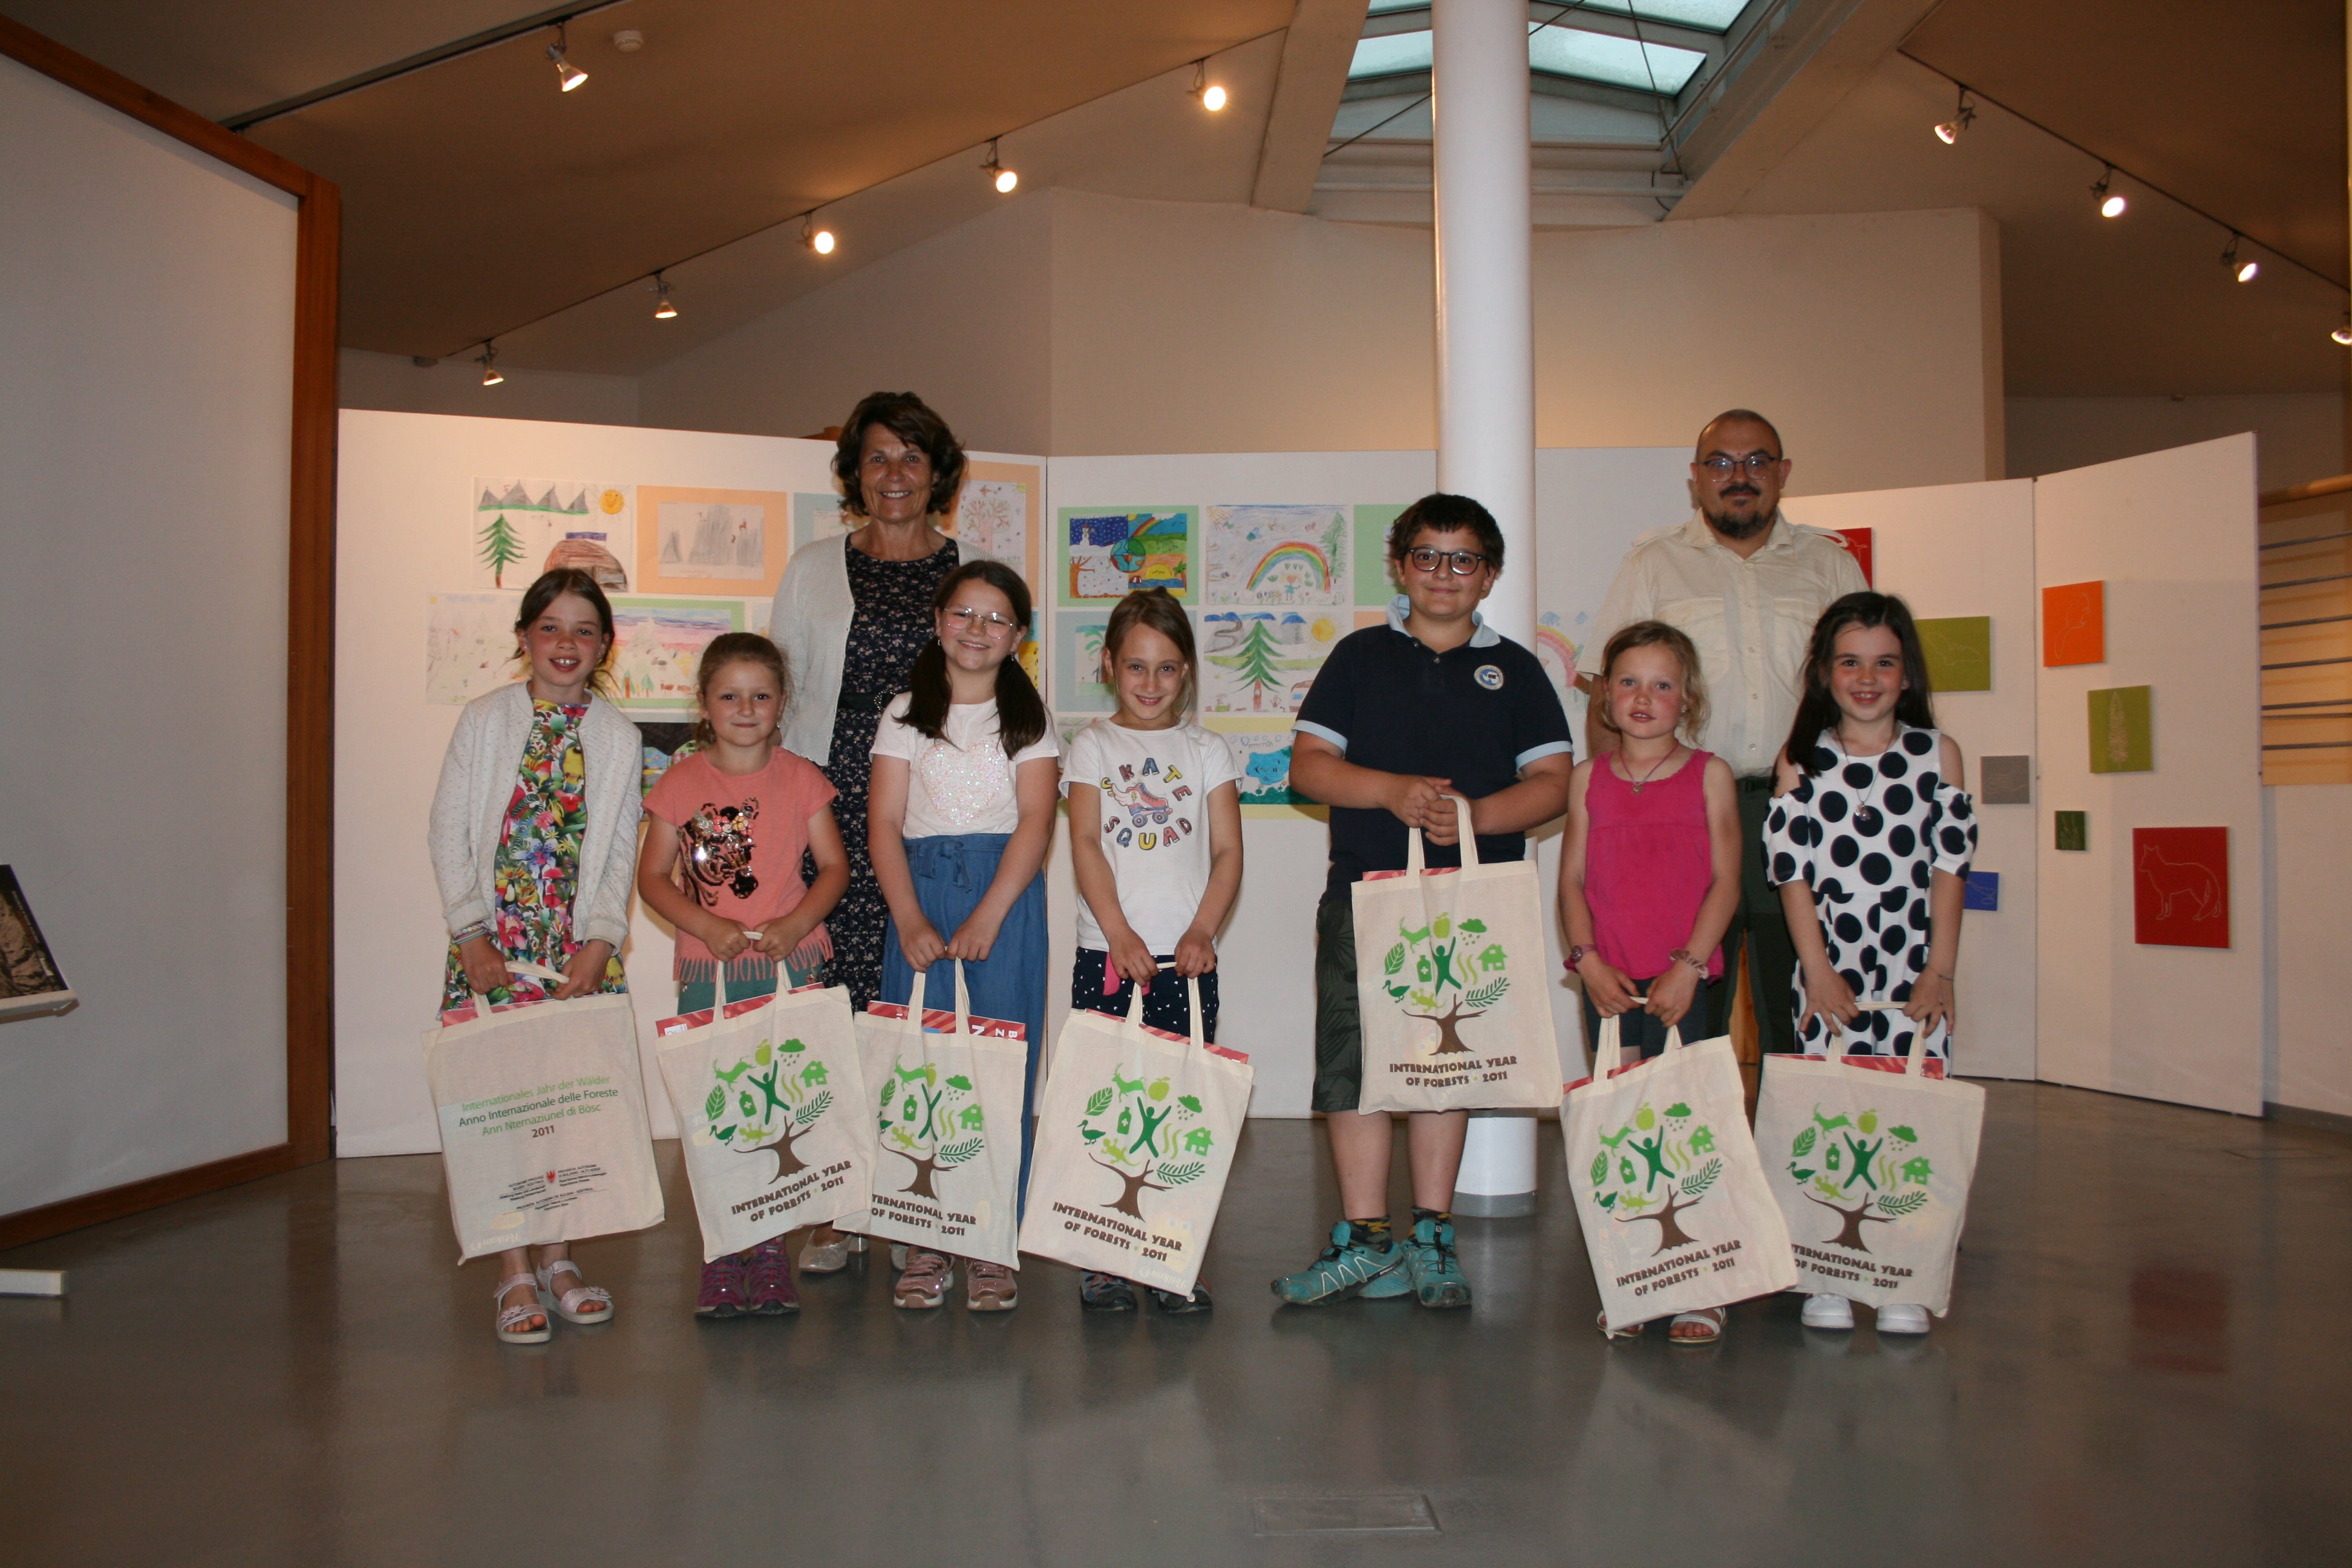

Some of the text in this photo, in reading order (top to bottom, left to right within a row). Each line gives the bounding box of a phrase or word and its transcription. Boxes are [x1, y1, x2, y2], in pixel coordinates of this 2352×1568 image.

[1103, 816, 1192, 851] SQUAD
[1390, 1056, 1517, 1074] INTERNATIONAL YEAR
[1405, 1071, 1508, 1088] OF FORESTS 2011
[459, 1088, 619, 1127] Anno Internazionale delle Foreste
[462, 1076, 611, 1112] Internationales Jahr der Wälder
[482, 1126, 503, 1136] Ann
[505, 1108, 564, 1131] Nternaziunel
[567, 1105, 576, 1116] di
[532, 1125, 555, 1138] 2011
[731, 1160, 852, 1215] INTERNATIONAL YEAR
[750, 1175, 844, 1222] OF FORESTS 2011
[872, 1194, 976, 1225] TERNATIONAL YEAR
[872, 1207, 965, 1236] OF FORESTS 2011
[1052, 1201, 1182, 1251] INTERNATIONAL YEAR
[1064, 1220, 1168, 1261] OF FORESTS 2011
[1616, 1249, 1710, 1287] INTERNATIONAL
[1712, 1240, 1742, 1256] YEAR
[1635, 1256, 1735, 1296] OF FORESTS 2011
[1791, 1243, 1913, 1277] TERNATIONAL YEAR
[1811, 1263, 1860, 1281] FORESTS
[1872, 1277, 1898, 1289] 2011
